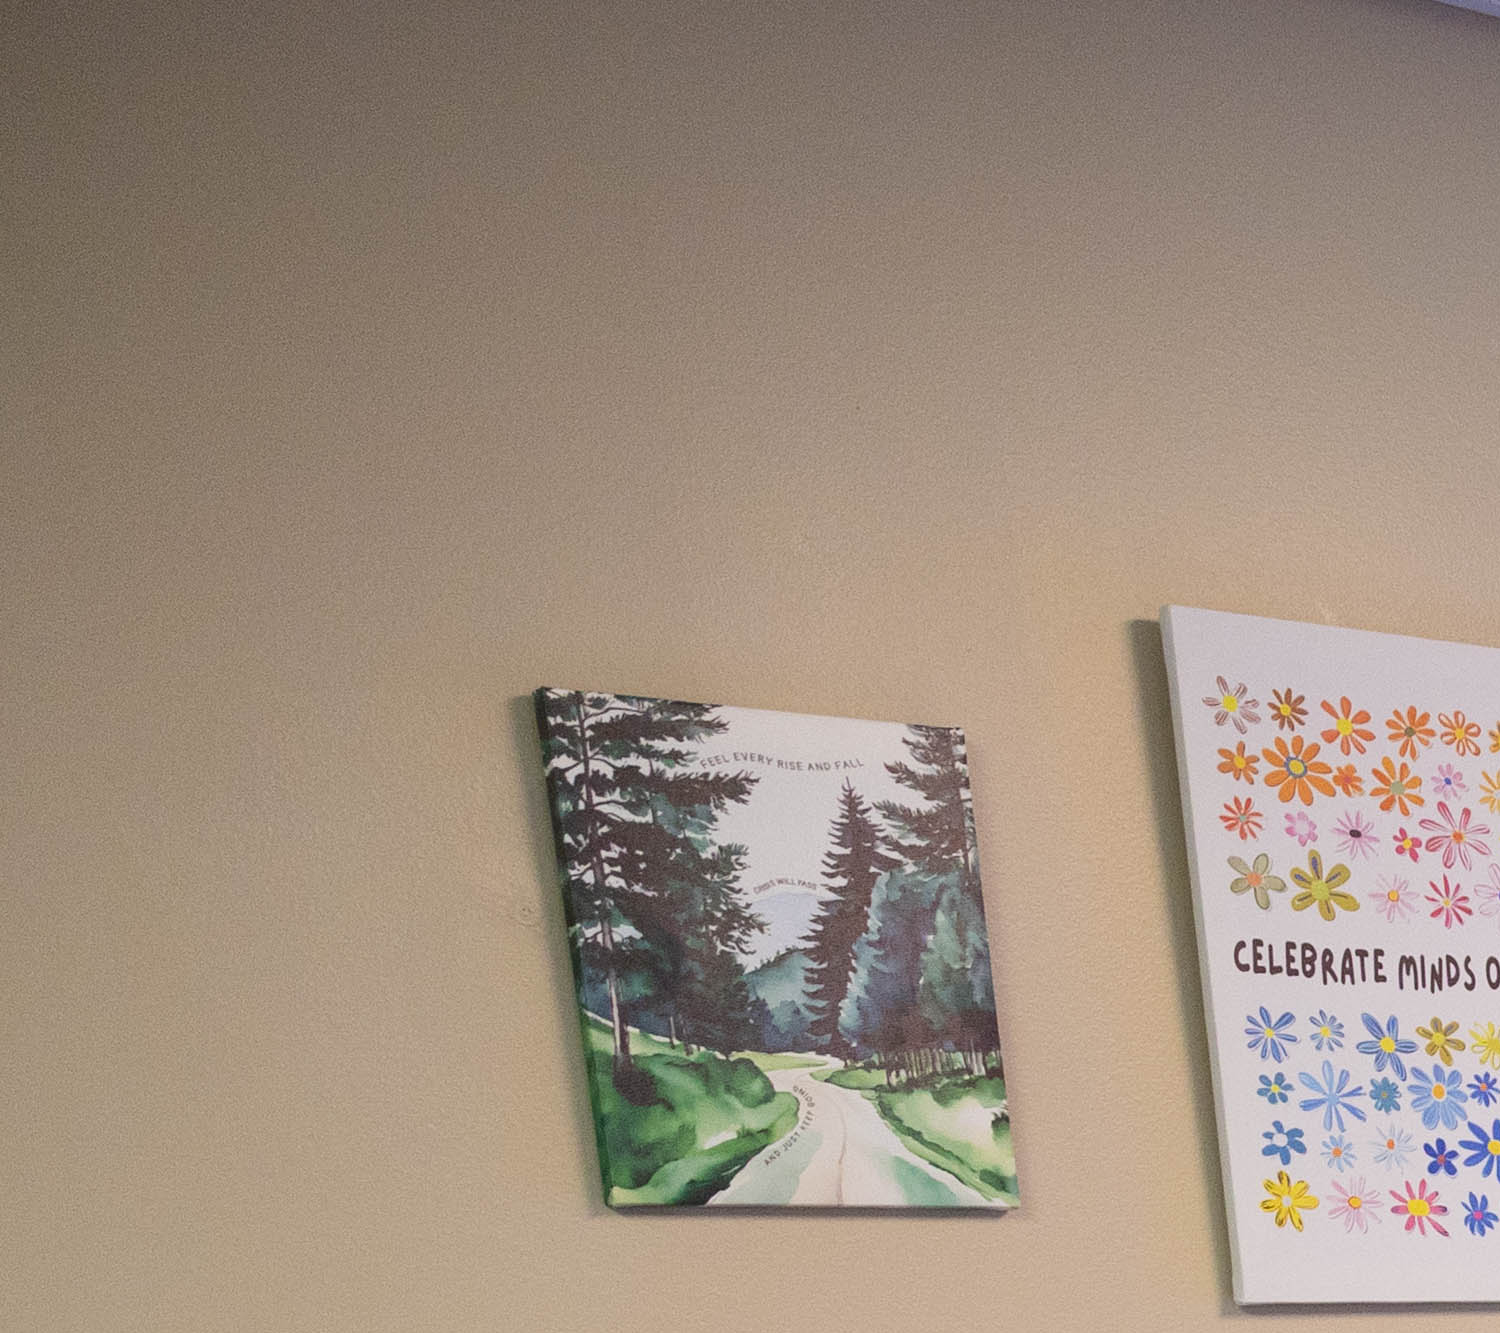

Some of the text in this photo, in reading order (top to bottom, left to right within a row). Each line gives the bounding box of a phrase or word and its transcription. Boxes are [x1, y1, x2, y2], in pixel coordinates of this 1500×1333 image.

[701, 752, 864, 771] FEEL EVERY RISE AND FALL
[1234, 939, 1387, 985] CELEBRATE
[1399, 954, 1476, 994] MINDS
[764, 1150, 780, 1166] AND
[782, 1132, 800, 1151] JUST
[793, 1085, 815, 1107] GOING
